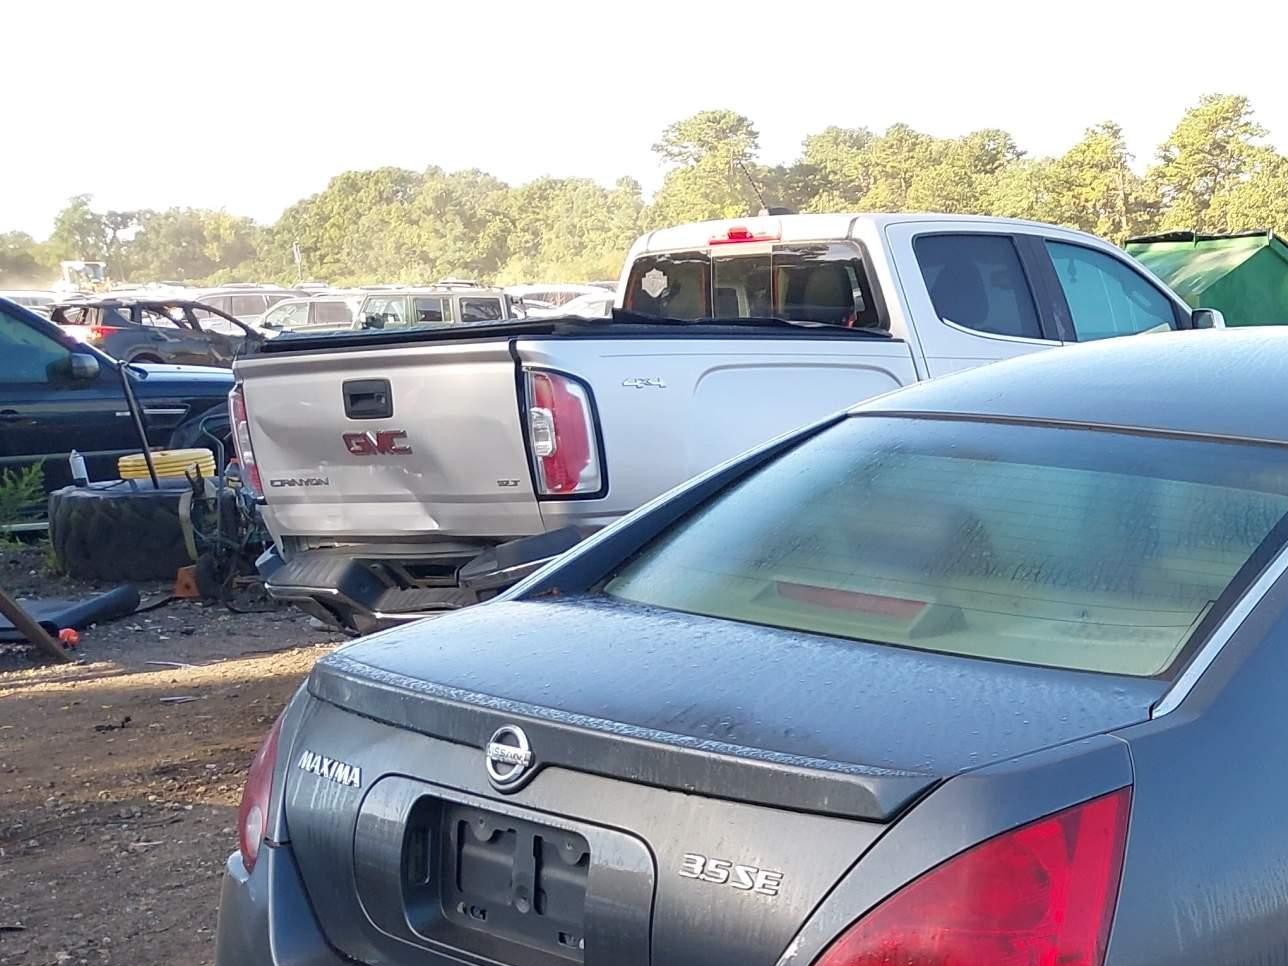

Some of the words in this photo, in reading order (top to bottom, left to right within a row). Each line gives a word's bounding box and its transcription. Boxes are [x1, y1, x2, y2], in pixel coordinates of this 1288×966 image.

[342, 430, 413, 455] GMC
[270, 477, 329, 487] CANYON
[297, 750, 362, 788] MAXIMA
